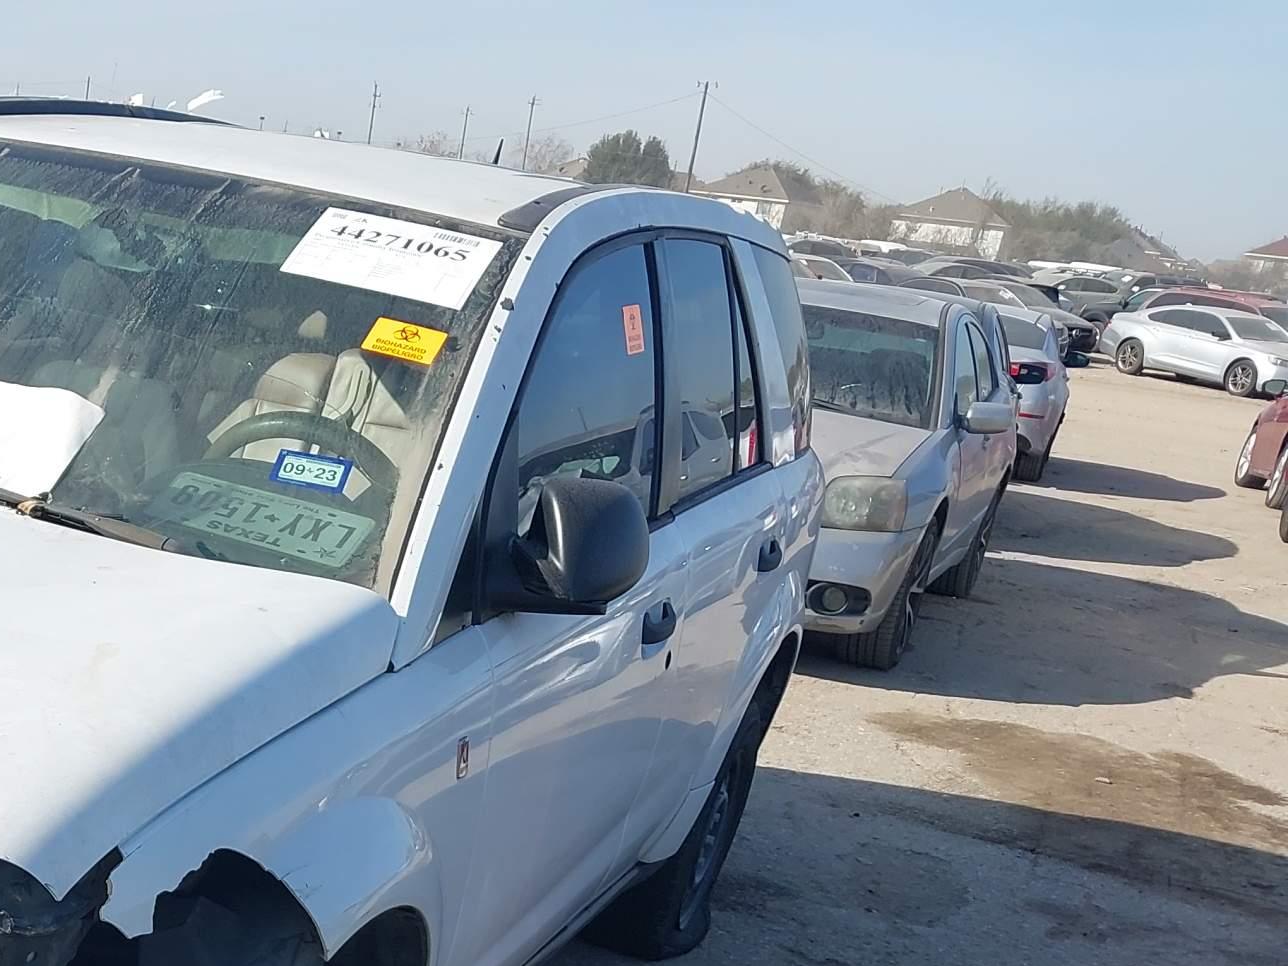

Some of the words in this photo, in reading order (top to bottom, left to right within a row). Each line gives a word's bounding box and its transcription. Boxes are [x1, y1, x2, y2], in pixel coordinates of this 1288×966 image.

[331, 225, 471, 262] 44271065
[372, 344, 423, 360] BIOPELIGRO
[376, 338, 427, 354] BIOHAZARD
[206, 520, 281, 547] TEXAS
